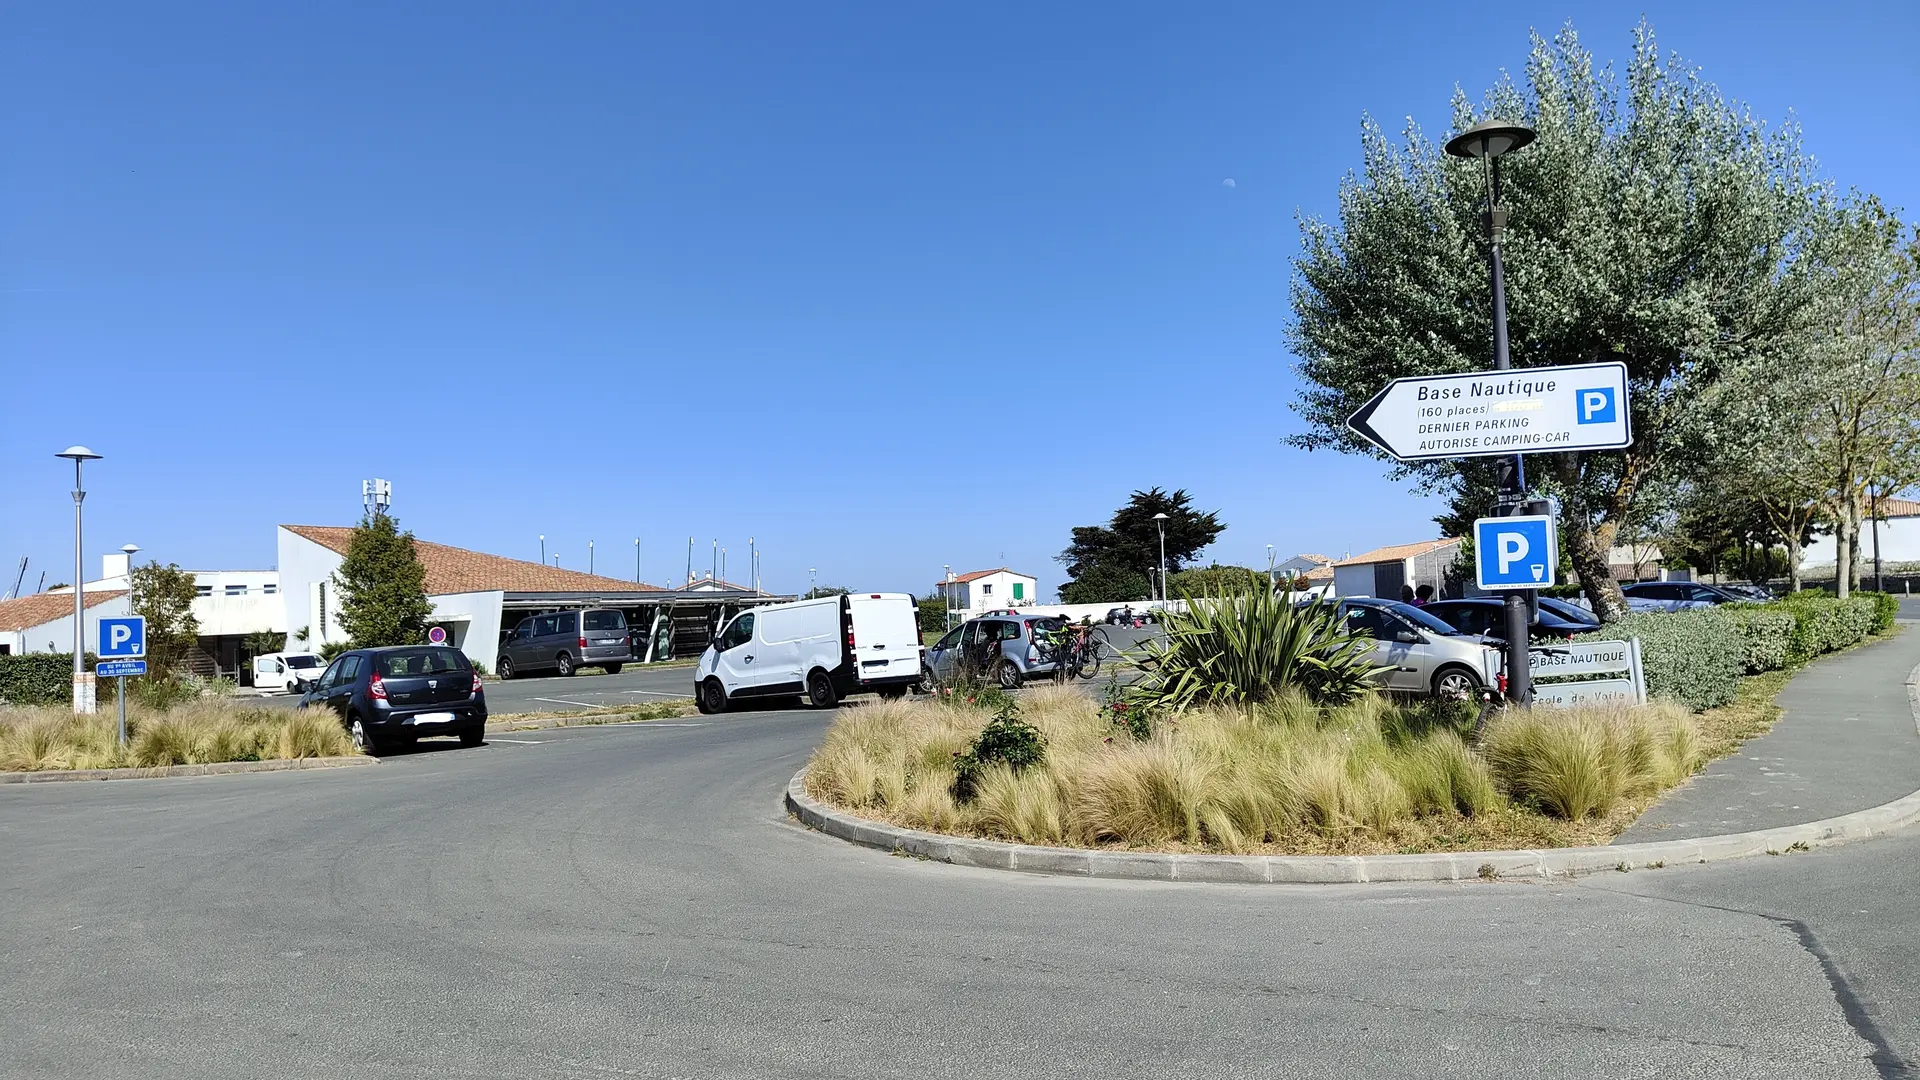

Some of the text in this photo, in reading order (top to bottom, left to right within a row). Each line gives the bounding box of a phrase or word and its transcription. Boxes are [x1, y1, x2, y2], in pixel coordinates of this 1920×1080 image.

[1417, 379, 1557, 401] Base Nautique
[1417, 406, 1442, 419] (160
[1447, 401, 1490, 418] places)
[1584, 392, 1608, 420] P
[1418, 417, 1529, 434] DERNIER PARKING
[1419, 431, 1571, 450] AUTORISE CAMPING-CAR
[1497, 533, 1529, 574] P
[111, 624, 132, 650] P
[1540, 656, 1566, 666] BASE
[1571, 652, 1624, 664] NAUTIQUE
[1572, 694, 1585, 702] de
[1594, 691, 1625, 700] Voile
